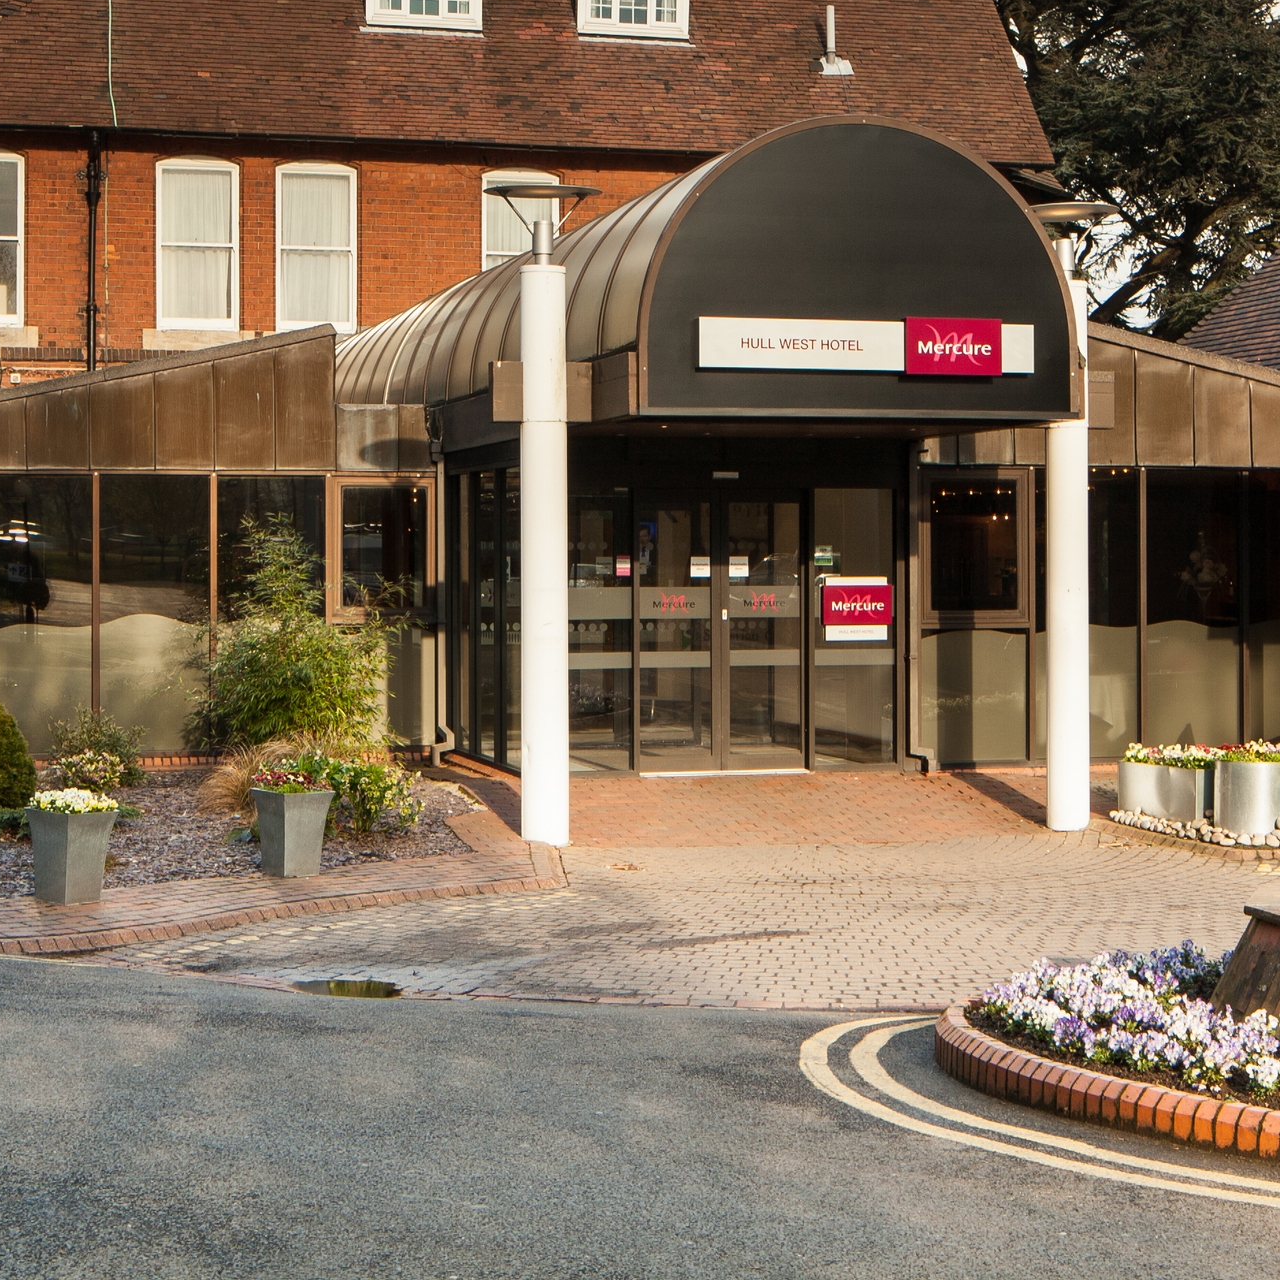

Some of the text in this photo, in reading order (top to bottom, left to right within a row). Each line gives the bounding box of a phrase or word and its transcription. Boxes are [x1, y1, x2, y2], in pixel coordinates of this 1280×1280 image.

[741, 337, 864, 351] HULL WEST HOTEL
[917, 340, 992, 356] Mercure
[652, 600, 696, 609] Mercure
[743, 599, 786, 608] Mercure
[831, 600, 885, 612] Mercure
